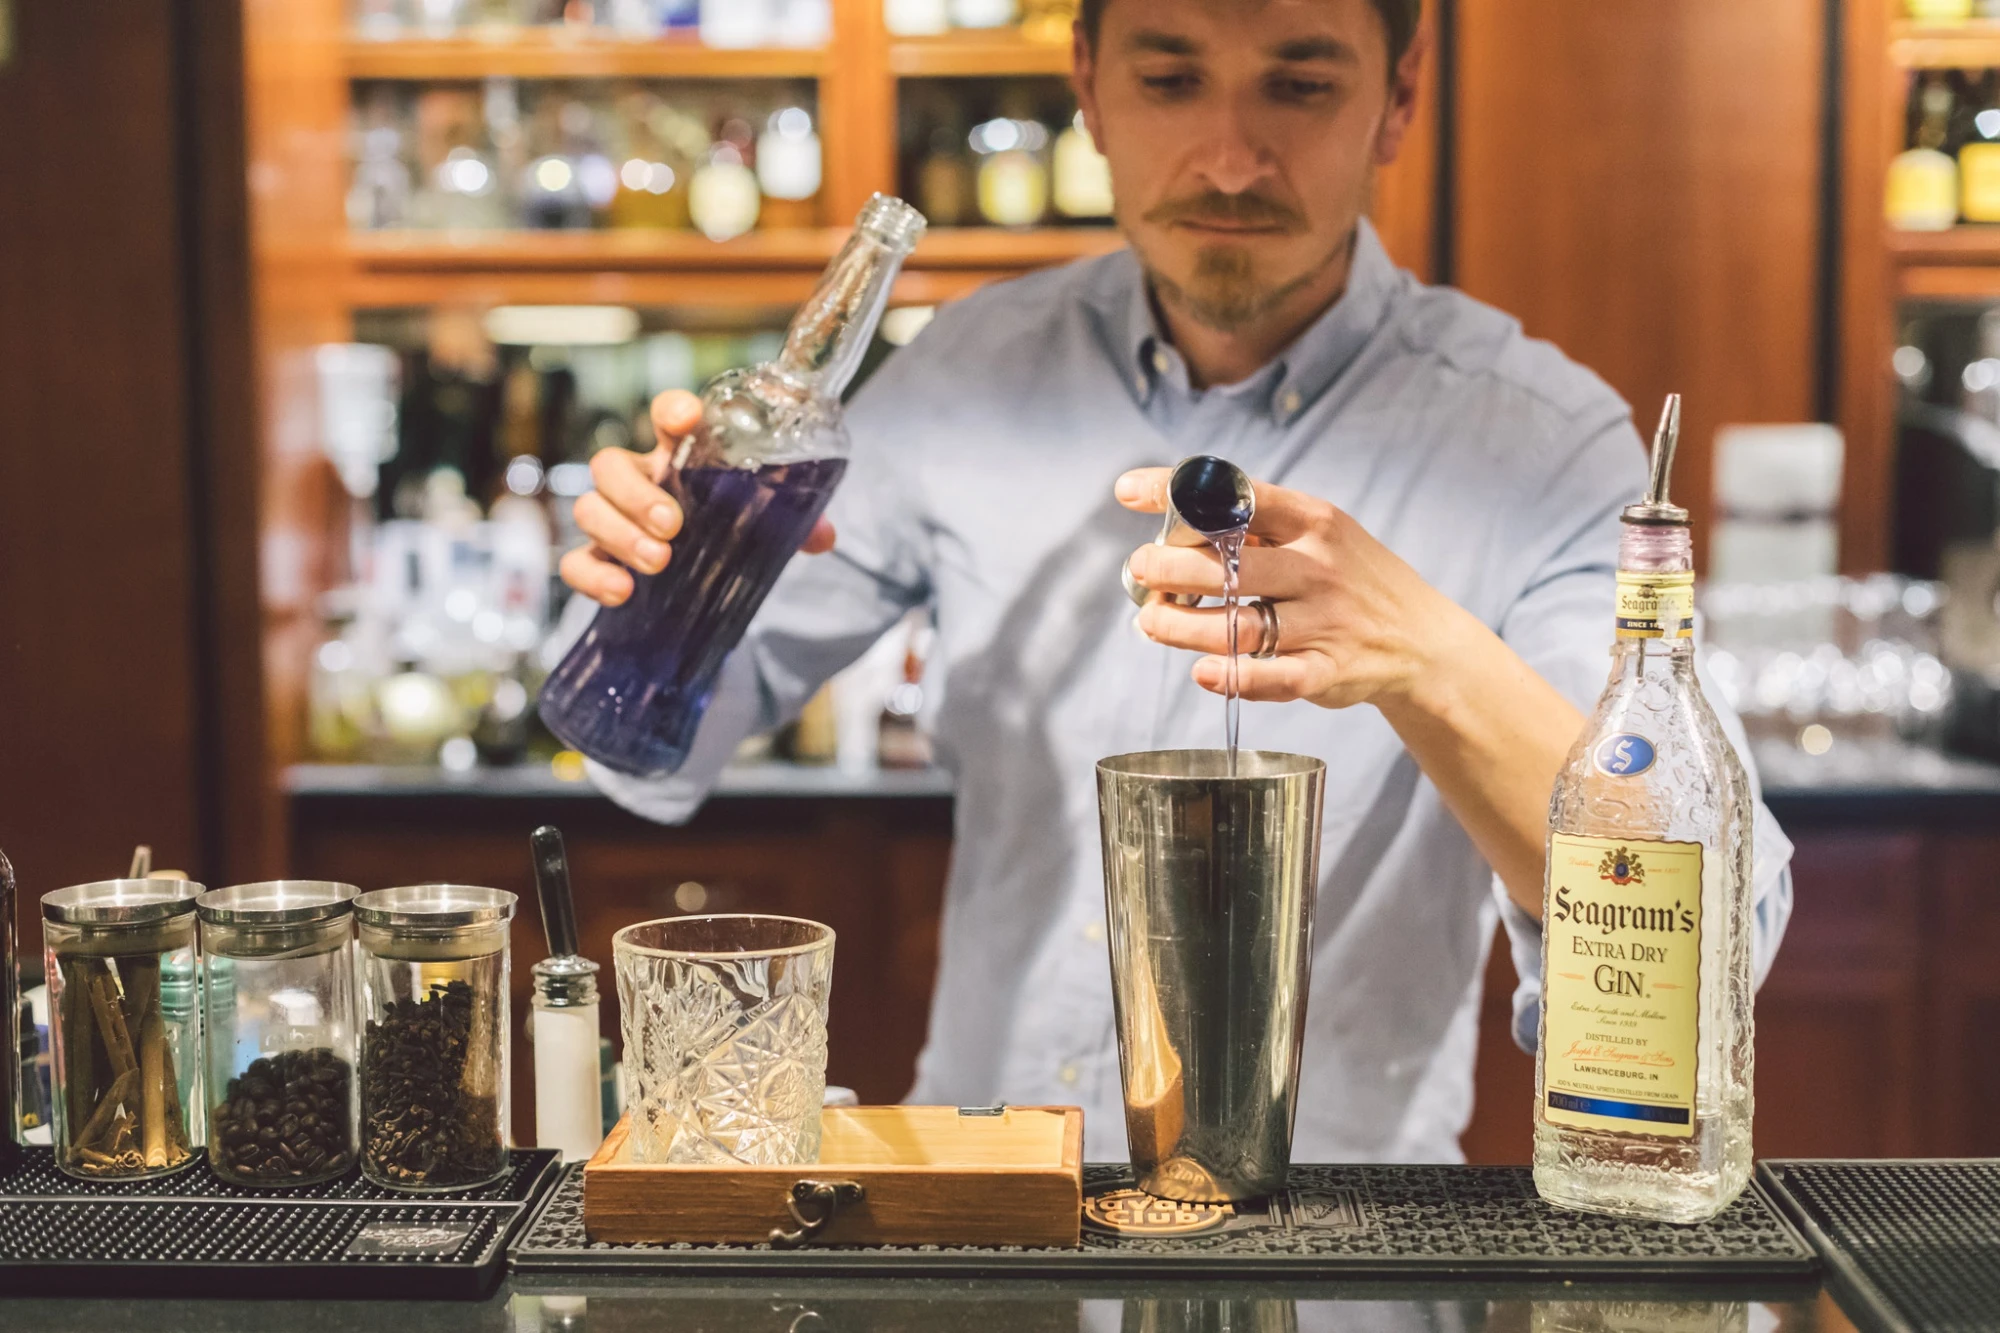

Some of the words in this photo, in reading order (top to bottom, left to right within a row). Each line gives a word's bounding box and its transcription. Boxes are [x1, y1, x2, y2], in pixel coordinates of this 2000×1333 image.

[1553, 885, 1695, 935] Seagram's
[1572, 935, 1627, 960] EXTRA
[1631, 942, 1668, 963] DRY
[1620, 1009, 1636, 1017] and
[1585, 1032, 1634, 1046] DISTILLED
[1635, 1038, 1648, 1047] BY
[1649, 1073, 1659, 1081] IN
[1572, 1082, 1595, 1092] NEUTRAL
[1616, 1088, 1644, 1097] DISTILLED
[1104, 1209, 1200, 1225] Club
